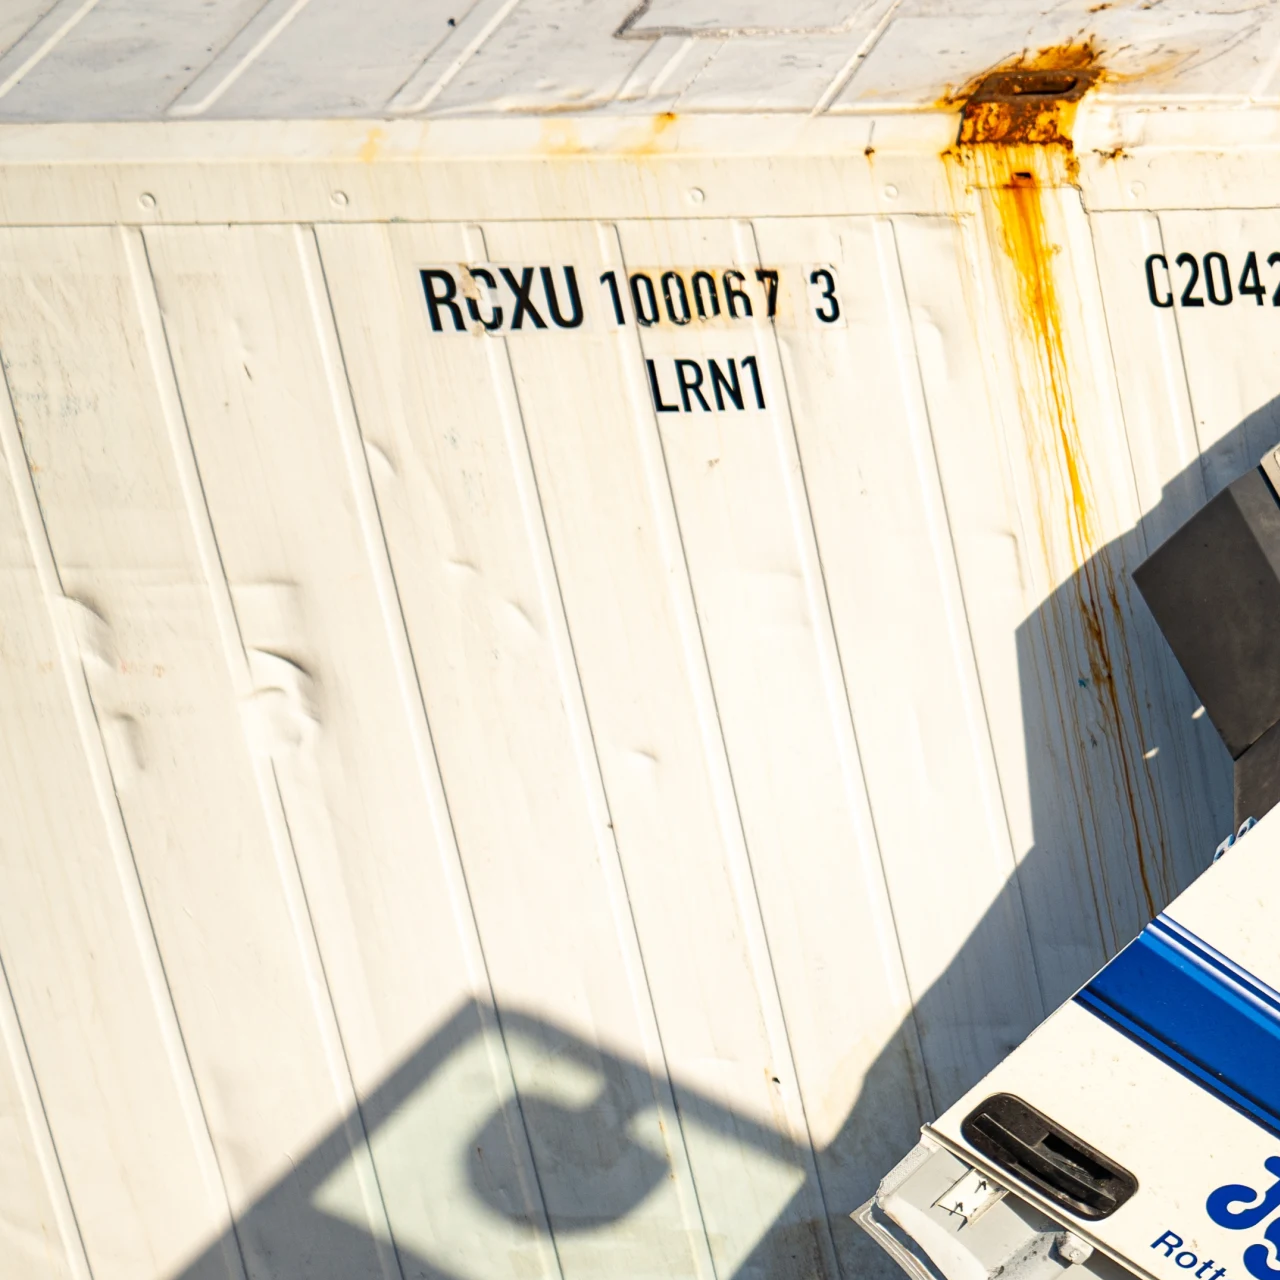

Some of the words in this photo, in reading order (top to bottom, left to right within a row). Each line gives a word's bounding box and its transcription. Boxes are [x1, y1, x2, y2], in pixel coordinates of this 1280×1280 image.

[418, 265, 586, 332] RCXU
[809, 268, 841, 324] 3
[644, 355, 767, 414] LRN1
